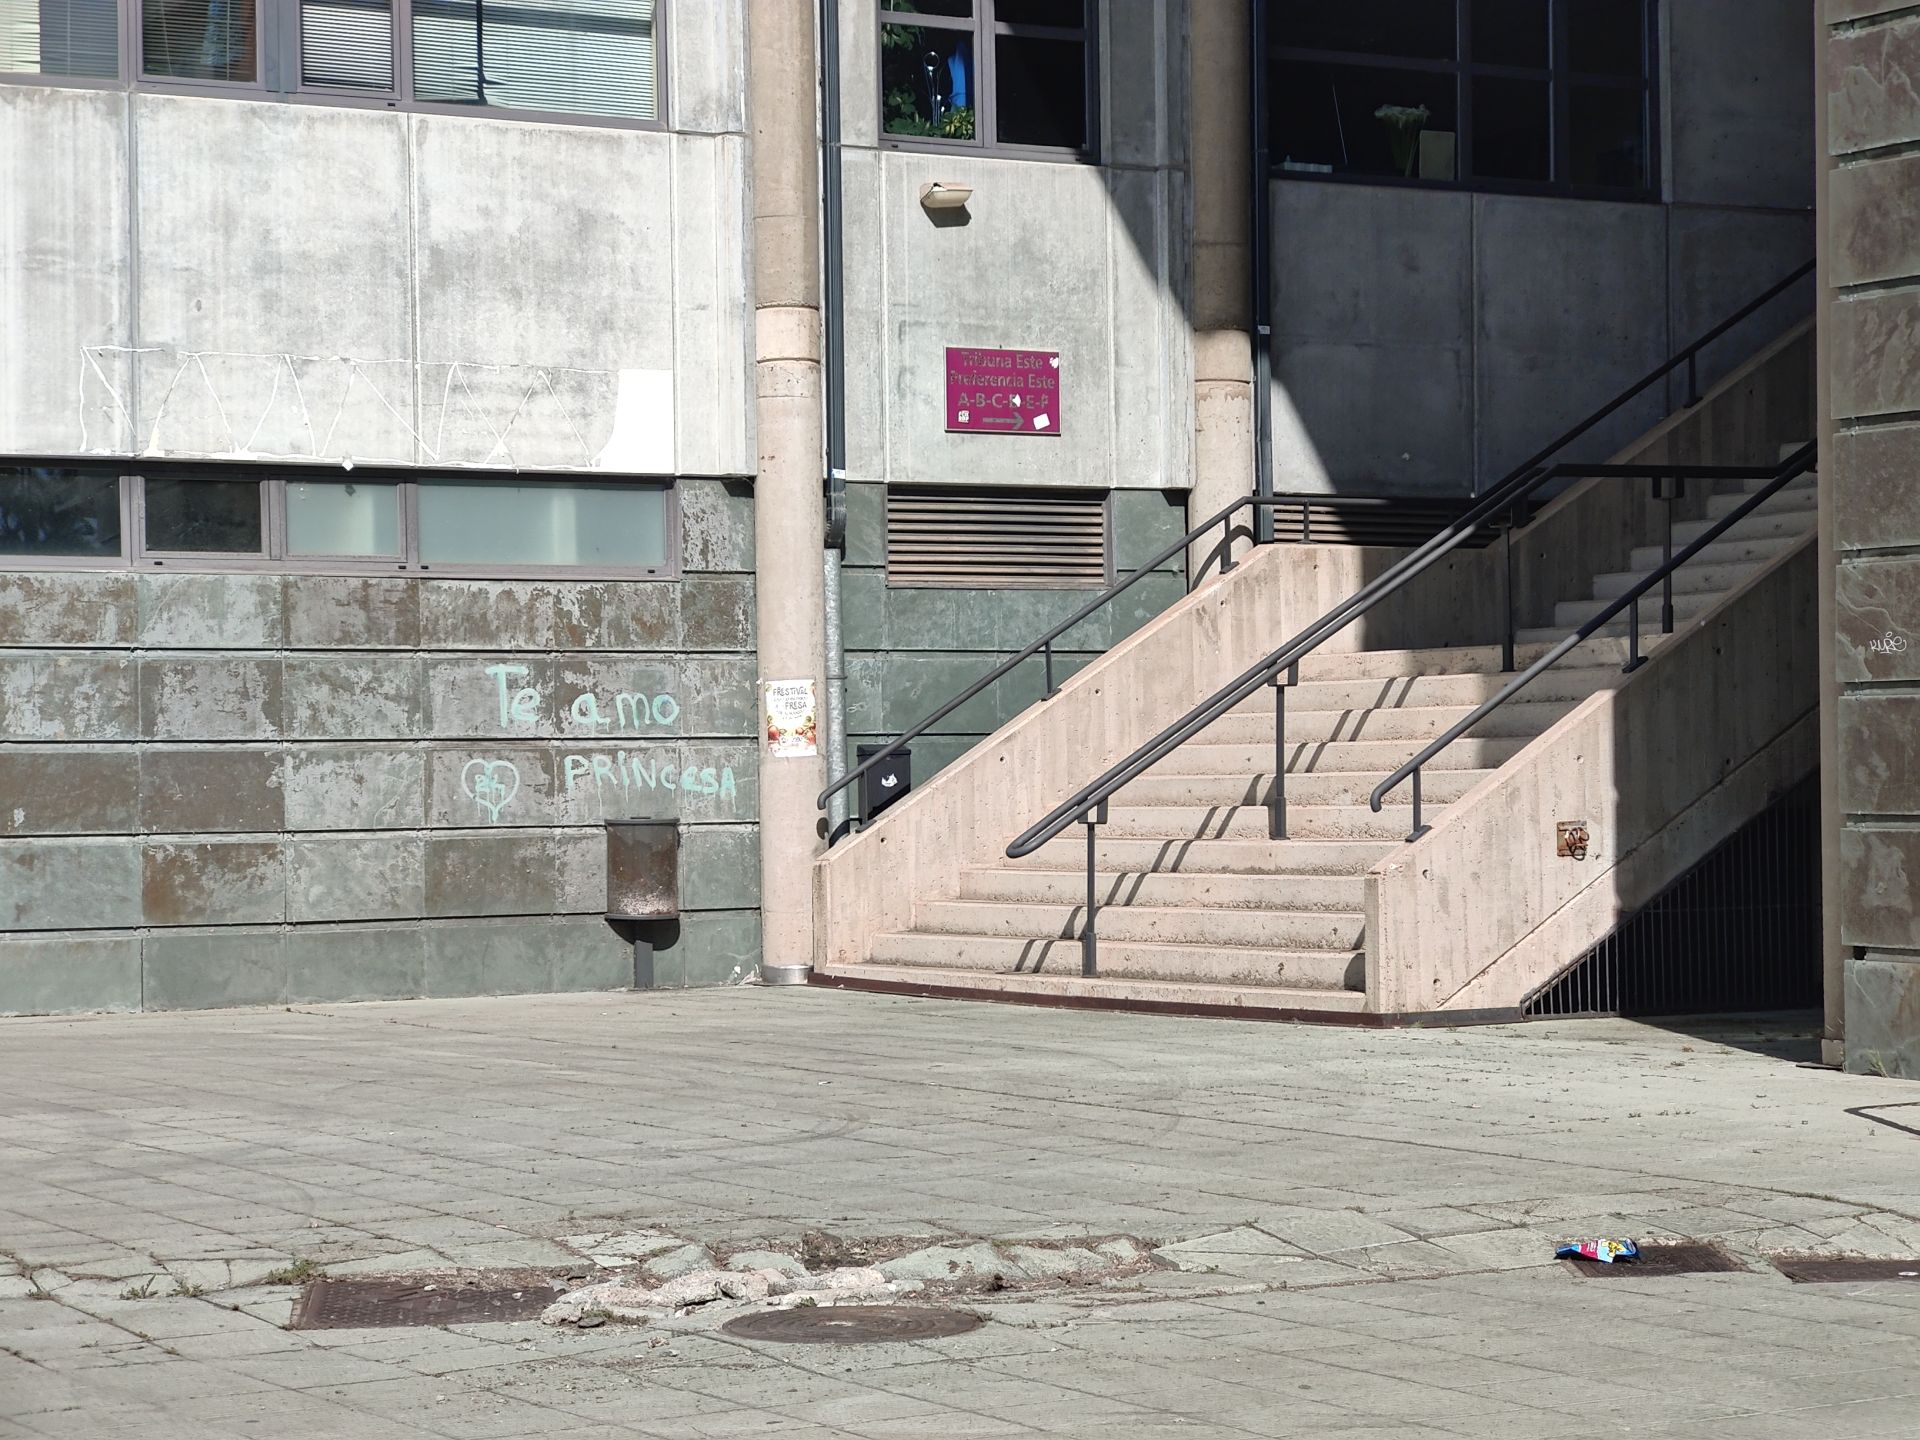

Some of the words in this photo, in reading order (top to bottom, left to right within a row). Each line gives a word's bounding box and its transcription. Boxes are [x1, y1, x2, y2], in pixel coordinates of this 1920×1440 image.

[961, 351, 1012, 368] Tribuna
[1016, 354, 1043, 369] Este
[950, 369, 1024, 388] Preferencia
[1028, 373, 1055, 389] Este
[484, 664, 541, 728] Te
[785, 700, 807, 710] FRESA
